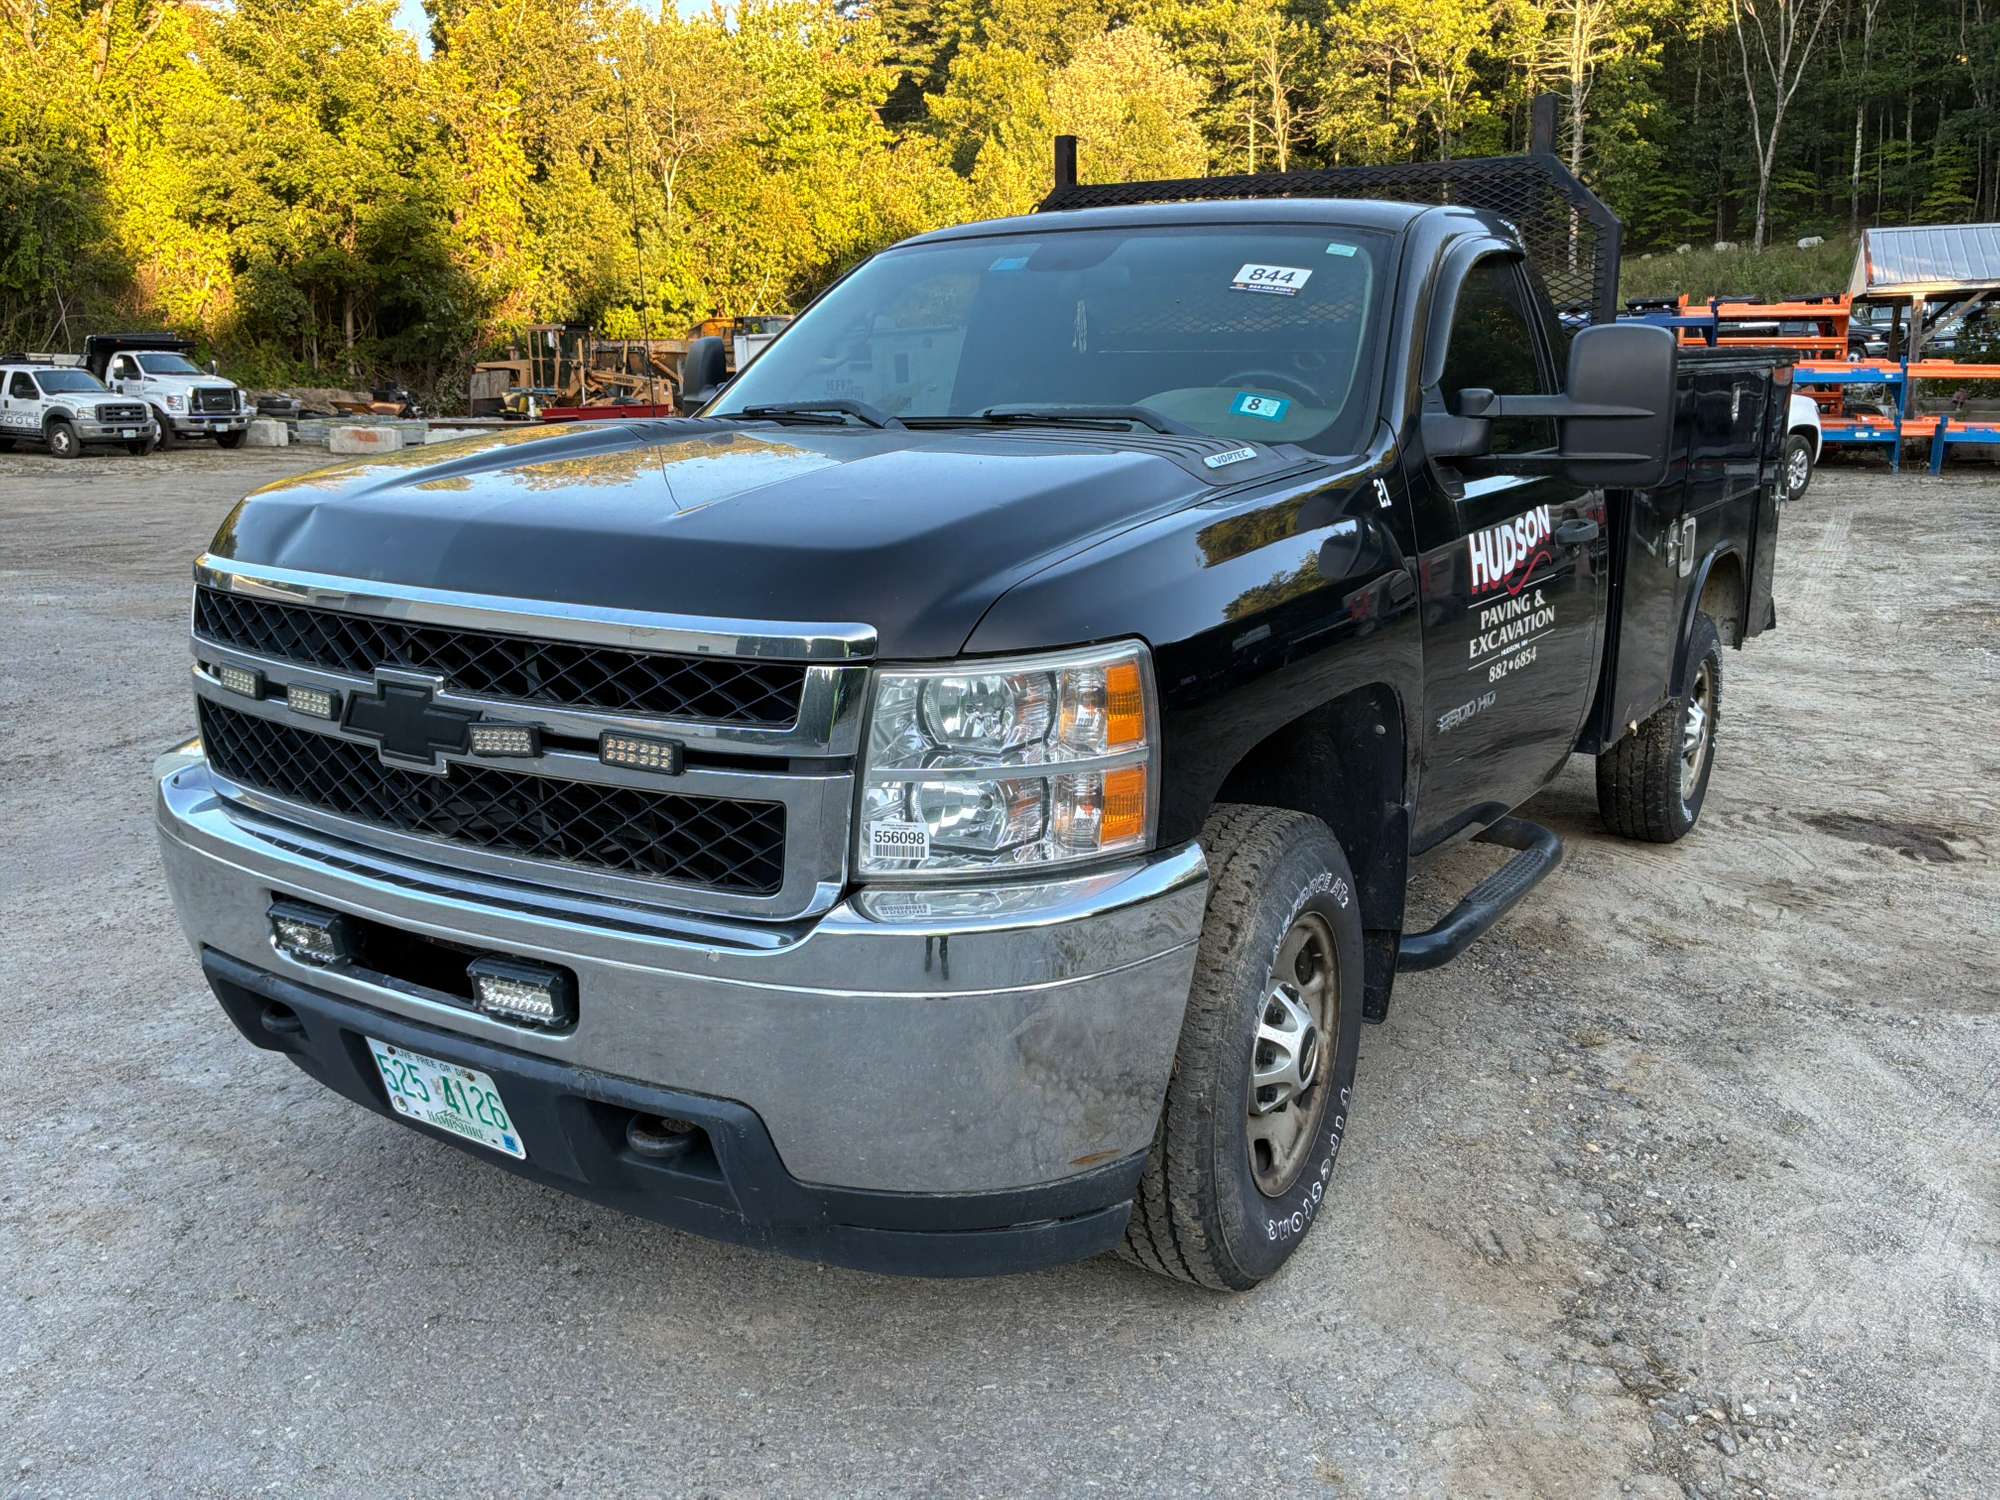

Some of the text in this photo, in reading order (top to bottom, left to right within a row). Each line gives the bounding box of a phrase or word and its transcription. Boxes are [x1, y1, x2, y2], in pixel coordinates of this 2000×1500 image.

[1249, 268, 1296, 283] 844
[1247, 398, 1262, 411] 8
[1212, 450, 1249, 465] VORTEC
[1372, 477, 1393, 509] 21
[1468, 503, 1551, 590] HUDSON
[1480, 588, 1546, 631] PAVING &
[1469, 605, 1555, 660] EXCAVATION
[874, 831, 925, 845] 556098
[415, 1055, 437, 1069] FREE
[439, 1063, 451, 1073] OR
[375, 1053, 509, 1132] 525 4126
